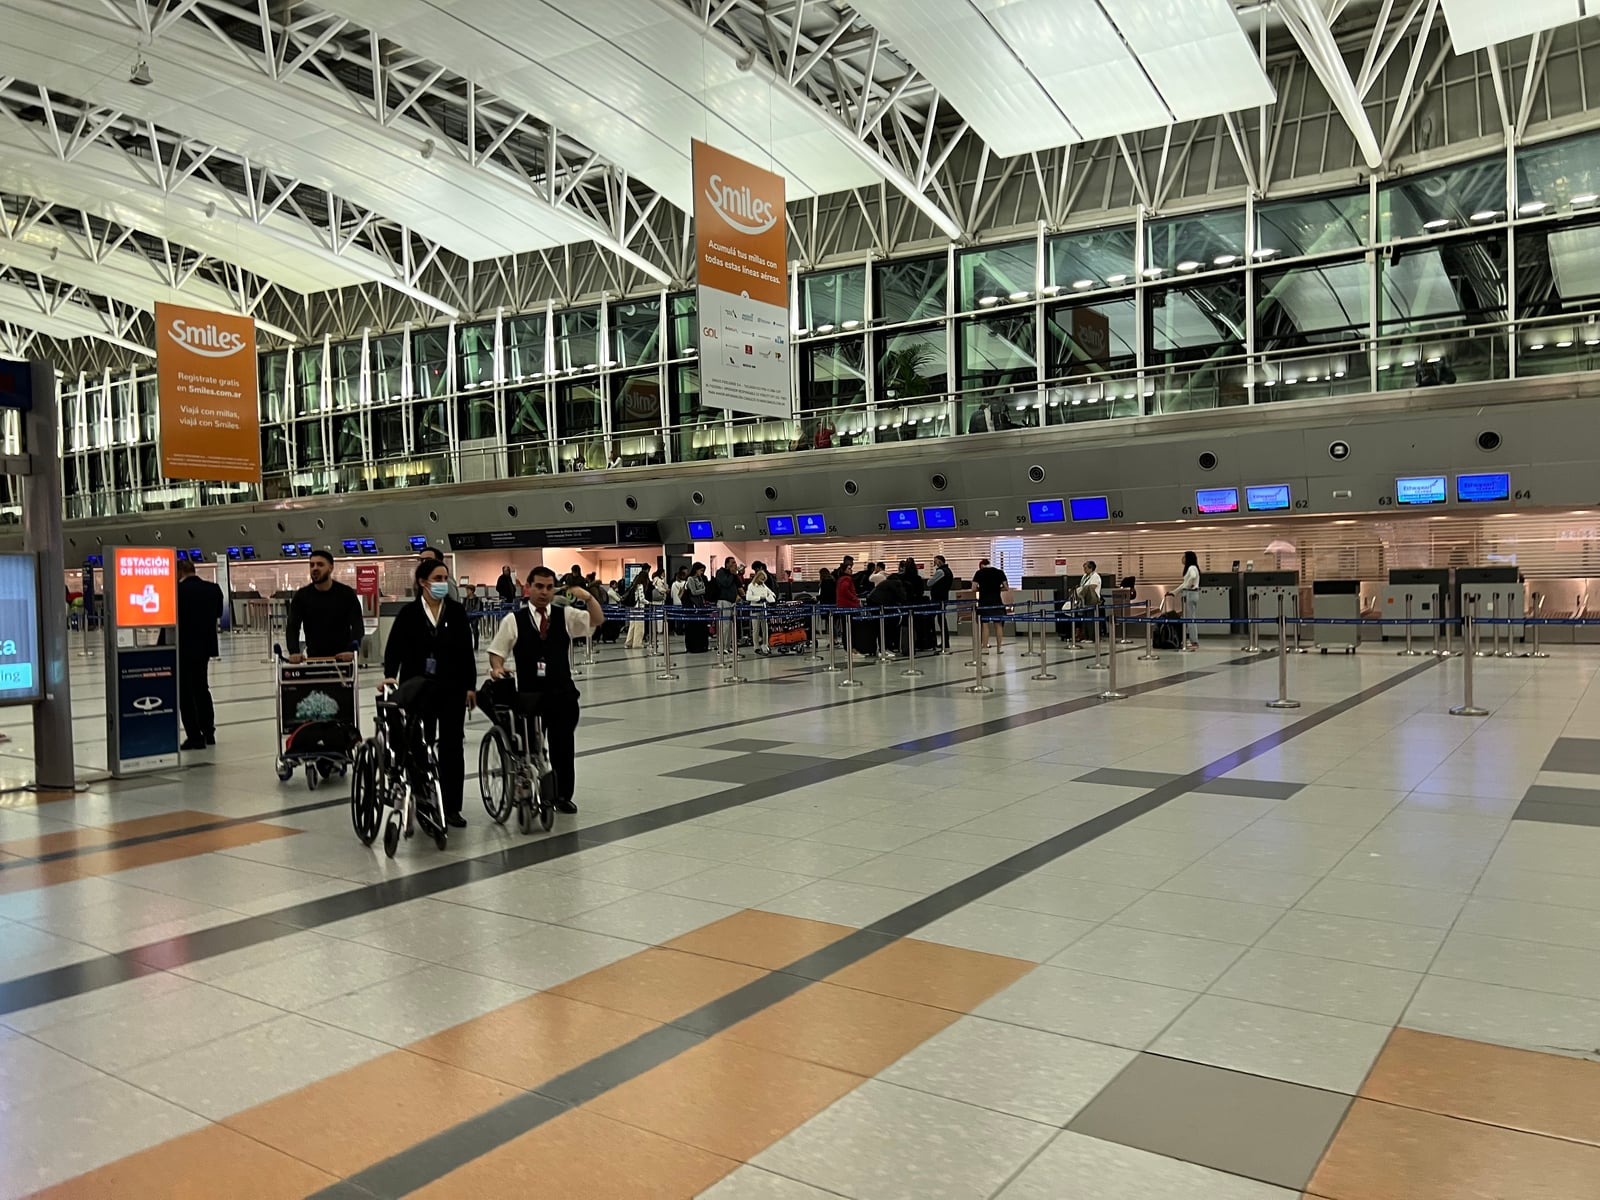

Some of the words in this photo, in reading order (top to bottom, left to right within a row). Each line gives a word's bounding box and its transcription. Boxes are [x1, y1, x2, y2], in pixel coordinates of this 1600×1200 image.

[707, 174, 775, 228] Smiles
[708, 239, 737, 256] Acumulá
[737, 249, 747, 260] tus
[748, 253, 766, 266] millas
[766, 260, 778, 269] con
[705, 254, 724, 267] todas
[724, 259, 741, 272] estas
[169, 319, 245, 352] Smiles
[702, 326, 719, 339] GOL
[218, 379, 240, 388] gratis
[176, 384, 187, 392] en
[188, 385, 242, 399] Smiles.com.ar
[180, 405, 199, 415] Viajá
[216, 409, 240, 420] millas,
[179, 417, 198, 428] viajá
[198, 419, 213, 427] con
[214, 420, 240, 430] Smiles.
[1378, 496, 1393, 506] 63
[1514, 490, 1531, 500] 64
[1182, 506, 1193, 515] 61
[1295, 500, 1309, 509] 62
[1016, 515, 1027, 523] 59
[1112, 510, 1124, 518] 60
[828, 525, 837, 533] 56
[120, 556, 170, 567] ESTACIÓN
[120, 567, 133, 576] DE
[135, 567, 170, 576] HIGIENE
[0, 639, 17, 655] a
[0, 669, 21, 683] ing
